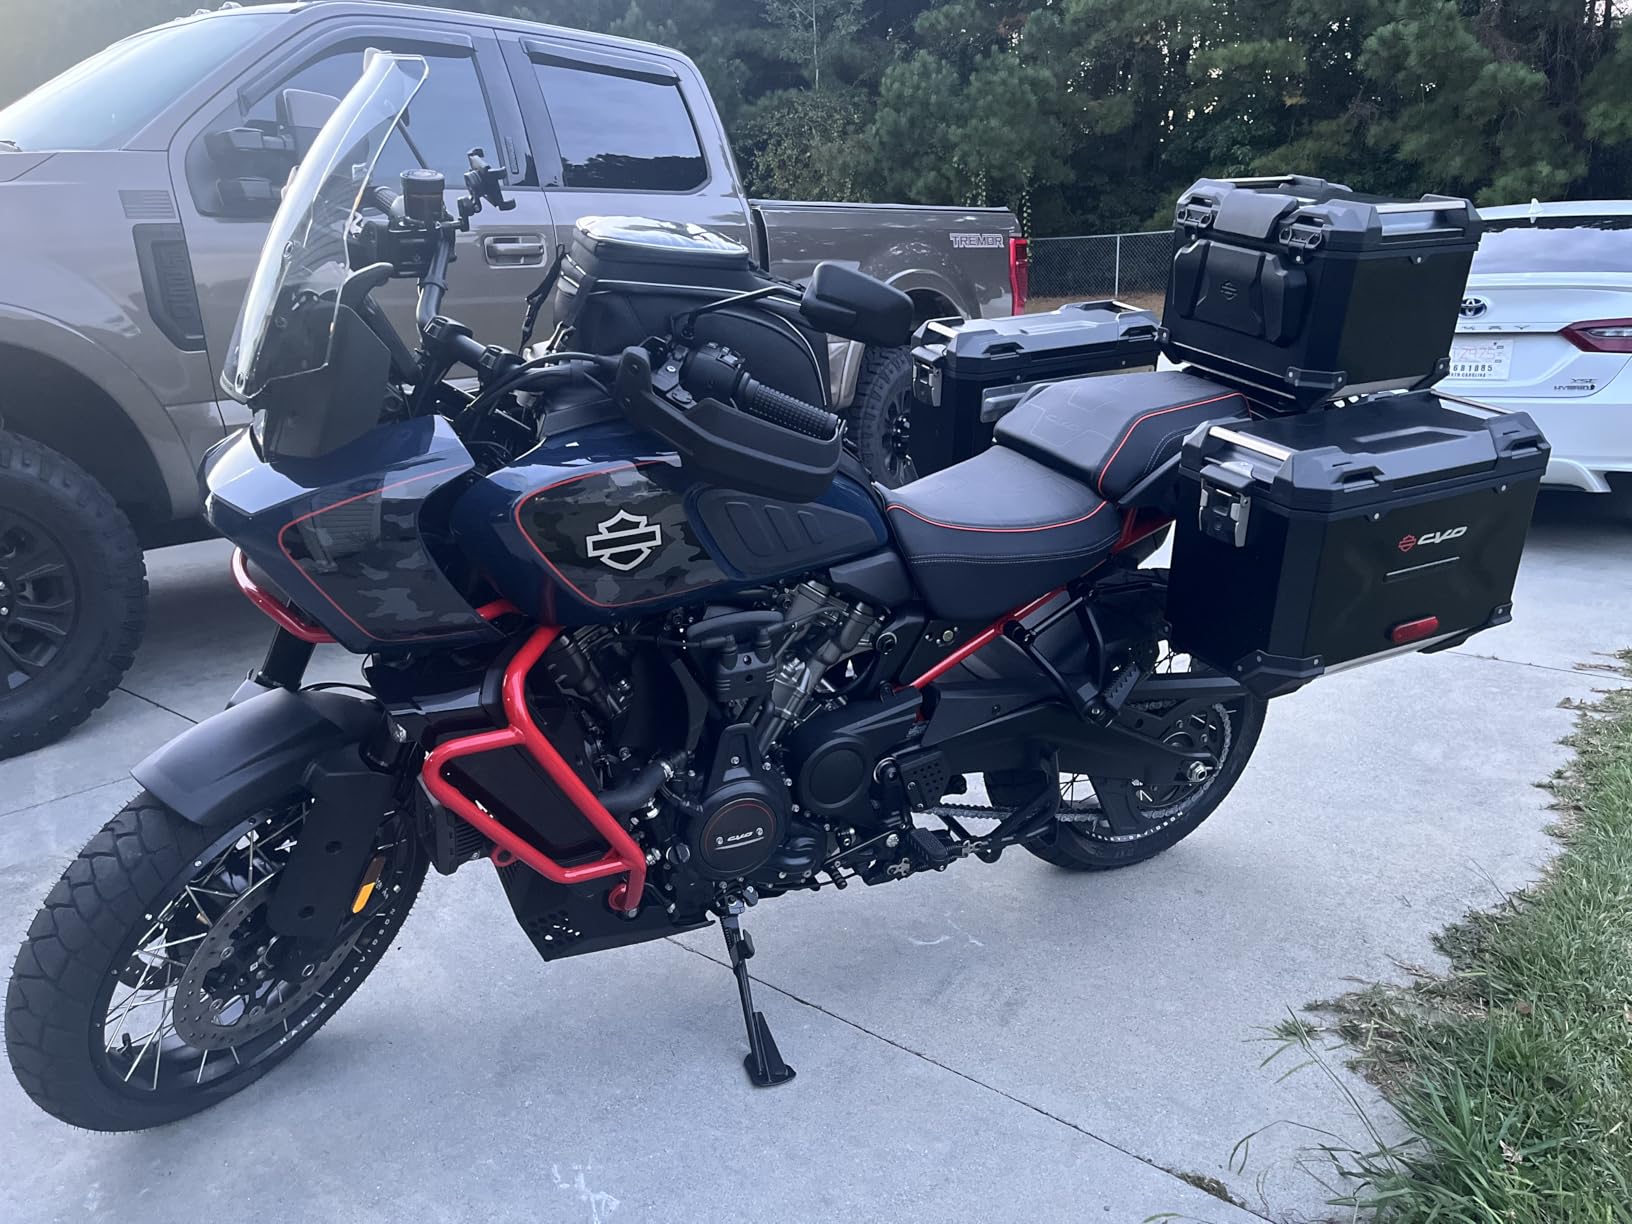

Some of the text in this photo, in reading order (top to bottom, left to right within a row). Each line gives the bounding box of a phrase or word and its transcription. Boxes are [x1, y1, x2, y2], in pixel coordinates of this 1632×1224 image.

[949, 233, 1005, 248] TREMOR
[1417, 526, 1468, 545] CVO
[727, 831, 755, 842] CVO
